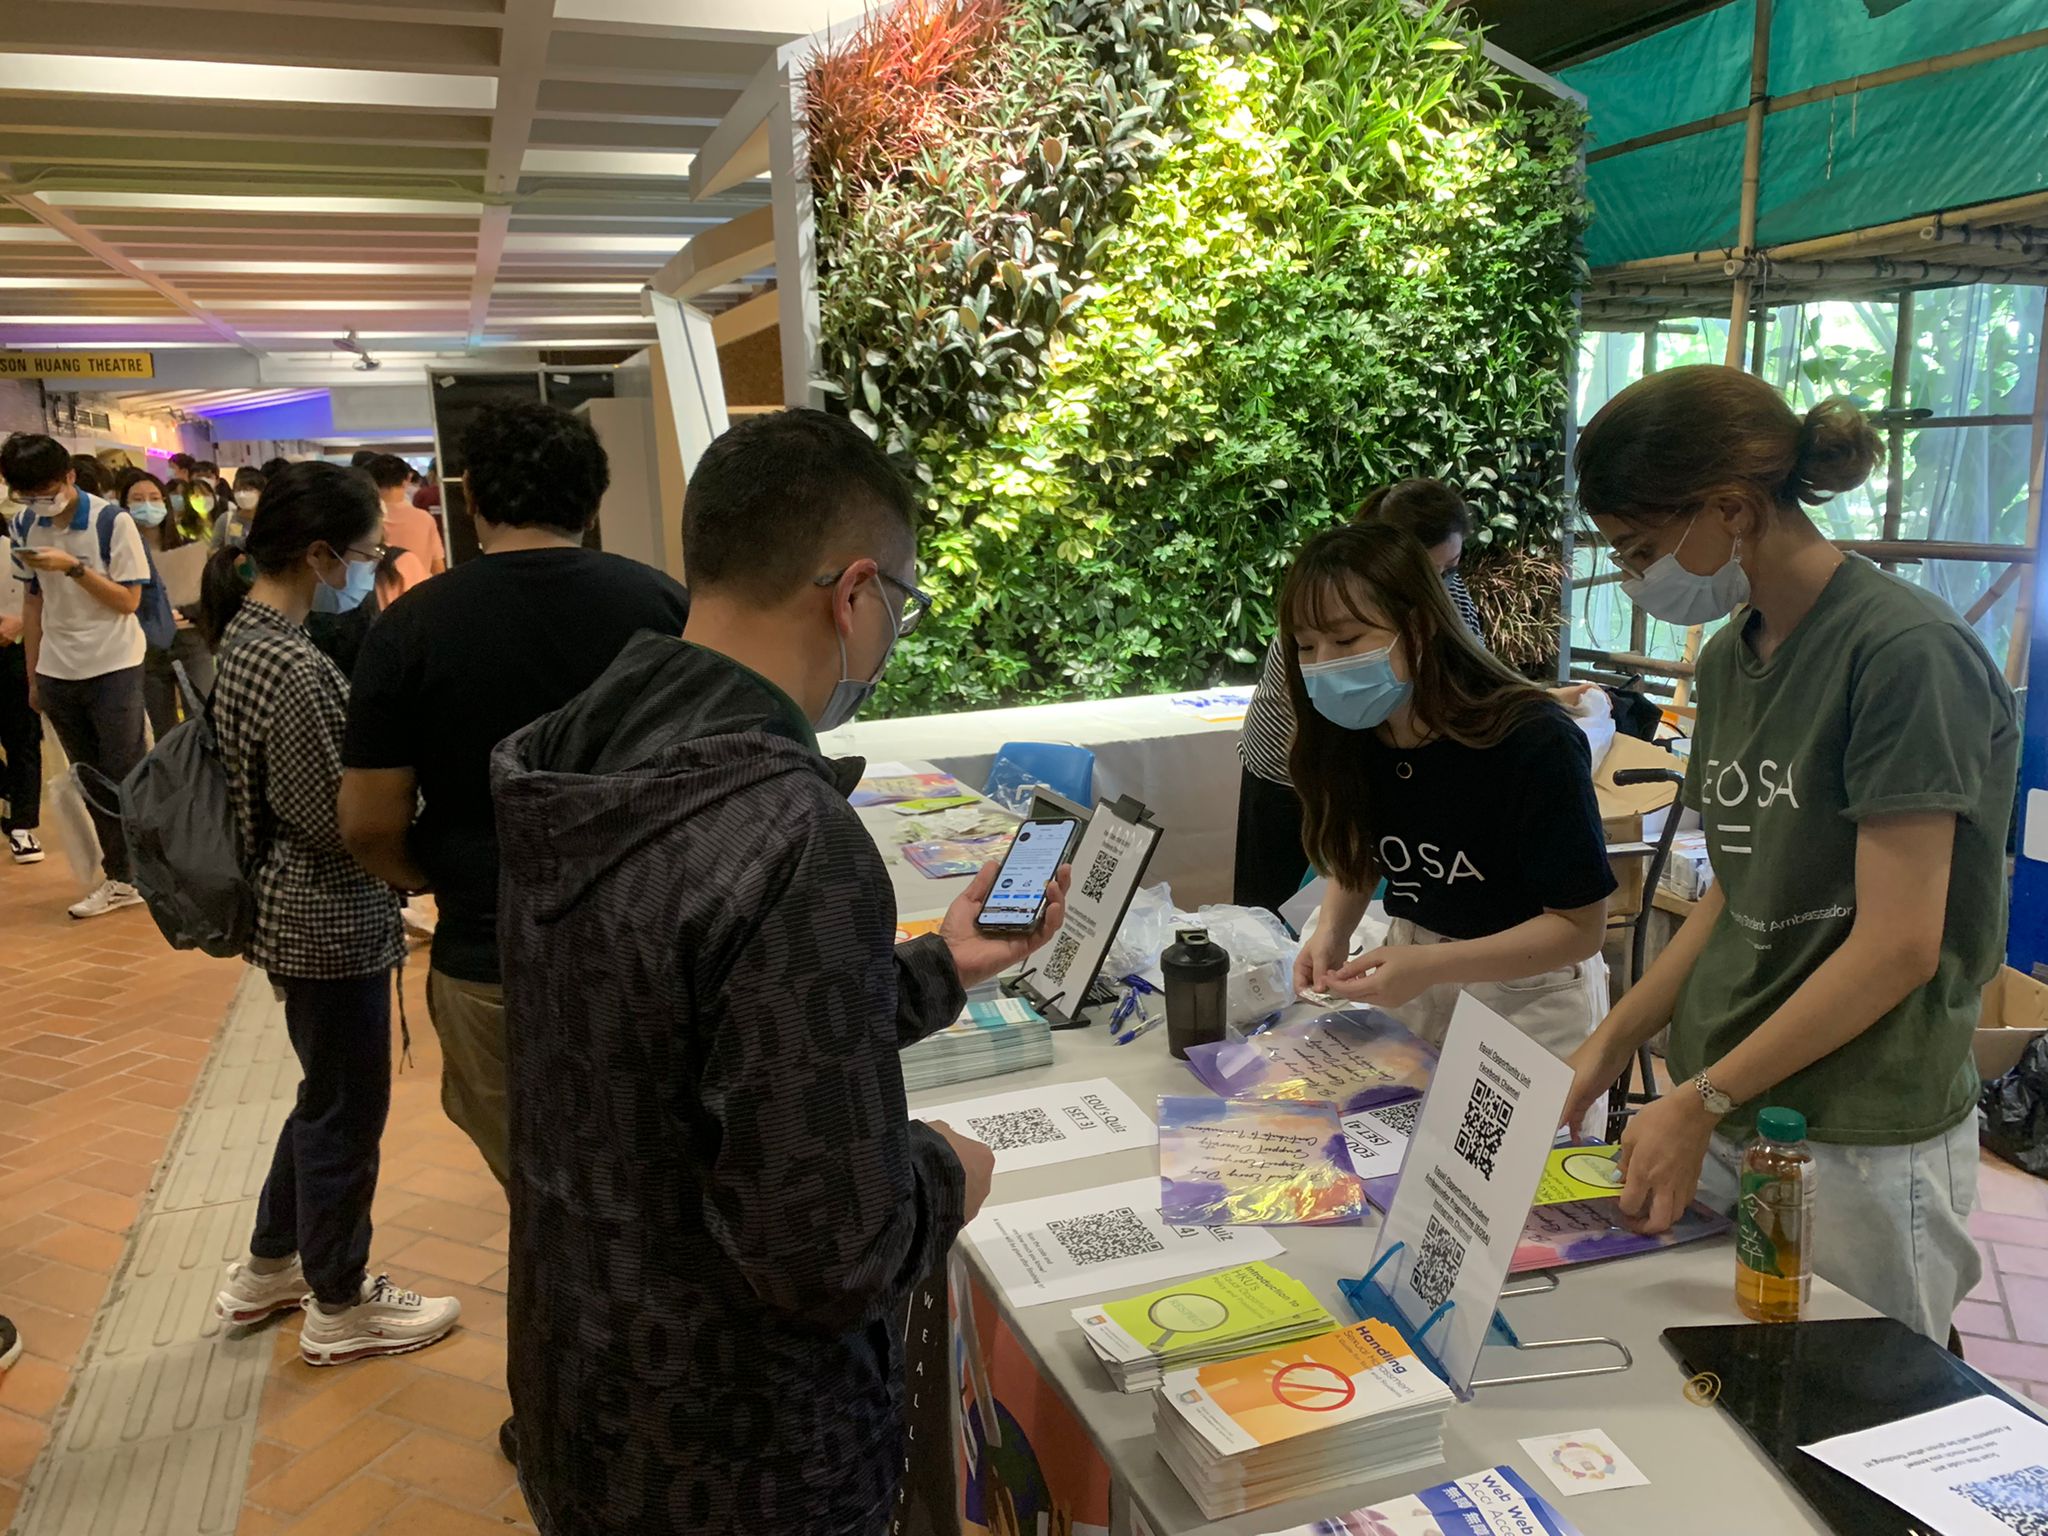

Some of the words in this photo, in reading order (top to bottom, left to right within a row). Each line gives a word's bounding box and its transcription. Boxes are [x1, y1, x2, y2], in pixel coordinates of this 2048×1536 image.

[0, 358, 27, 372] SON
[35, 358, 80, 372] HUANG
[88, 358, 143, 371] THEATRE
[1371, 836, 1485, 885] OSA
[1770, 904, 1853, 932] Ambassador
[1479, 1041, 1494, 1058] Equal
[1492, 1051, 1521, 1080] Opportunity
[1520, 1072, 1531, 1088] Unit
[1479, 1061, 1501, 1084] Facebook
[1500, 1078, 1520, 1099] Channel
[1062, 1106, 1089, 1121] (SET
[1080, 1121, 1097, 1130] 3)
[1084, 1094, 1110, 1116] EOU's
[1104, 1116, 1127, 1133] Quiz
[1255, 1145, 1309, 1159] Support
[1356, 1130, 1391, 1146] (SET
[1260, 1157, 1305, 1170] Respect
[1207, 1225, 1233, 1241] uiz
[1232, 1269, 1260, 1292] HKU's
[1245, 1266, 1291, 1302] Introduction
[1290, 1299, 1299, 1308] to
[1344, 1330, 1371, 1354] Sexual
[1368, 1354, 1415, 1393] Harassment
[1355, 1326, 1407, 1374] Handling
[1482, 1475, 1511, 1502] Web
[1507, 1505, 1533, 1535] Web
